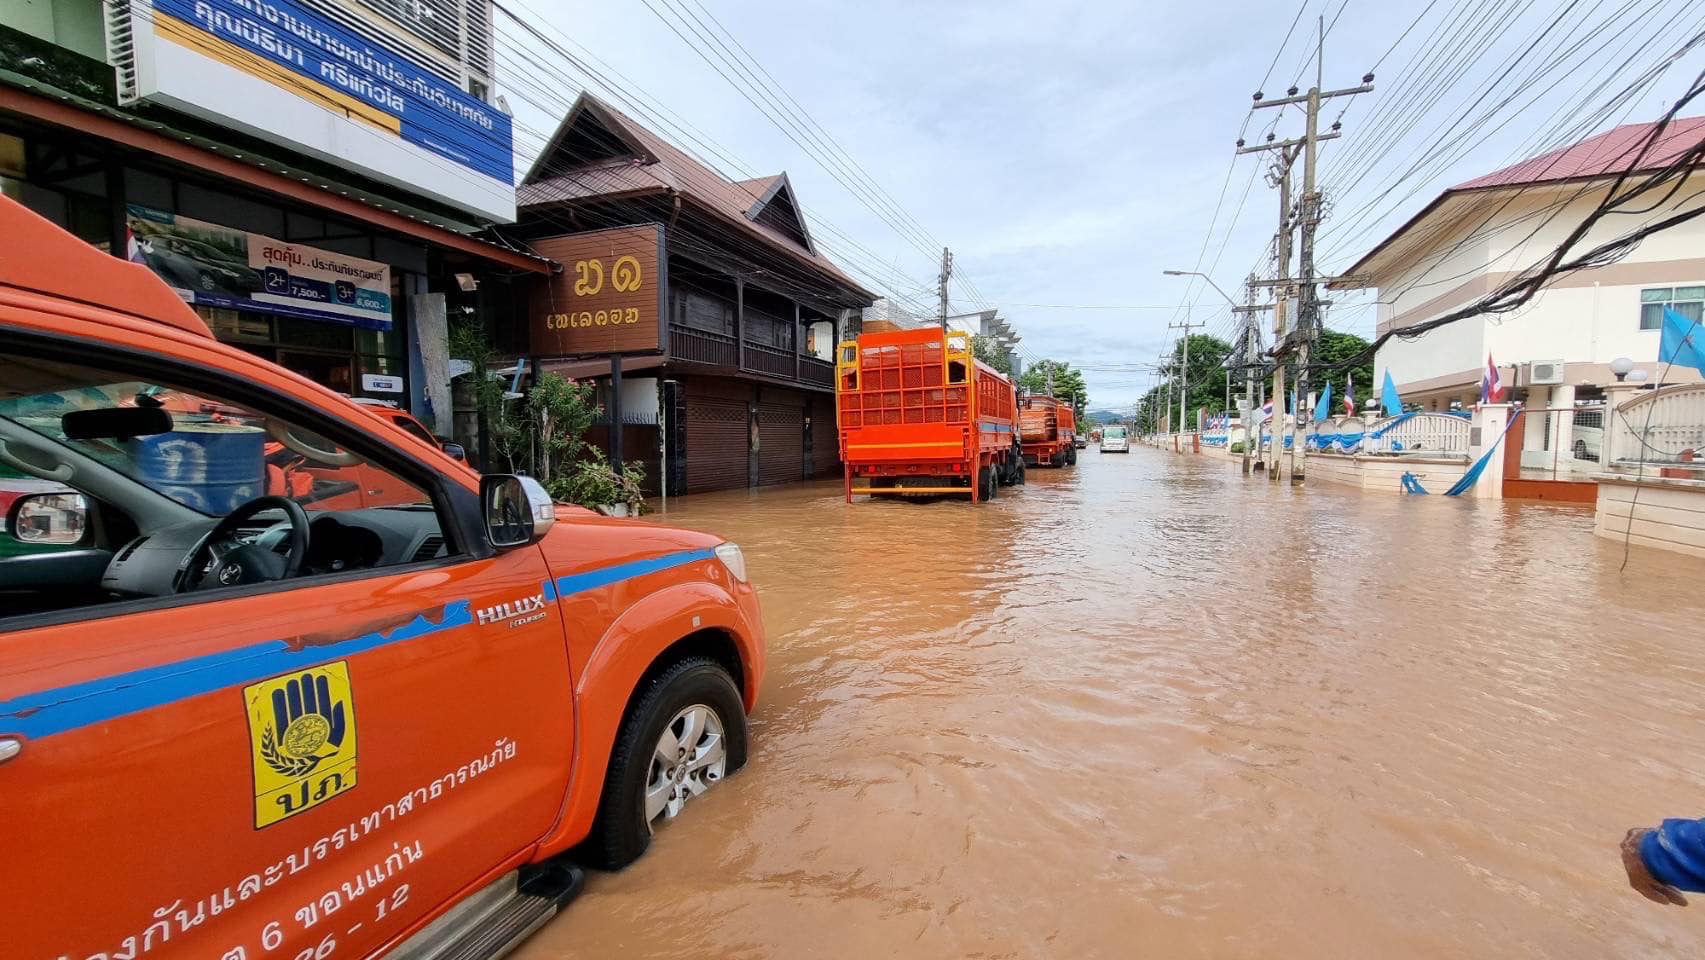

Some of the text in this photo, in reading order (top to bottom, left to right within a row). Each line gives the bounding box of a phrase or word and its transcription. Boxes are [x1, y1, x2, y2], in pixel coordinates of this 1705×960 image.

[268, 272, 286, 288] 2+
[337, 285, 354, 299] 3+
[476, 594, 545, 626] HILUX
[275, 772, 348, 815] ปภ.
[57, 737, 517, 960] งกันและบรรเทาสาธารณภัย
[261, 920, 284, 952] 6
[294, 839, 424, 930] ขอนแก่น
[374, 883, 410, 923] 12
